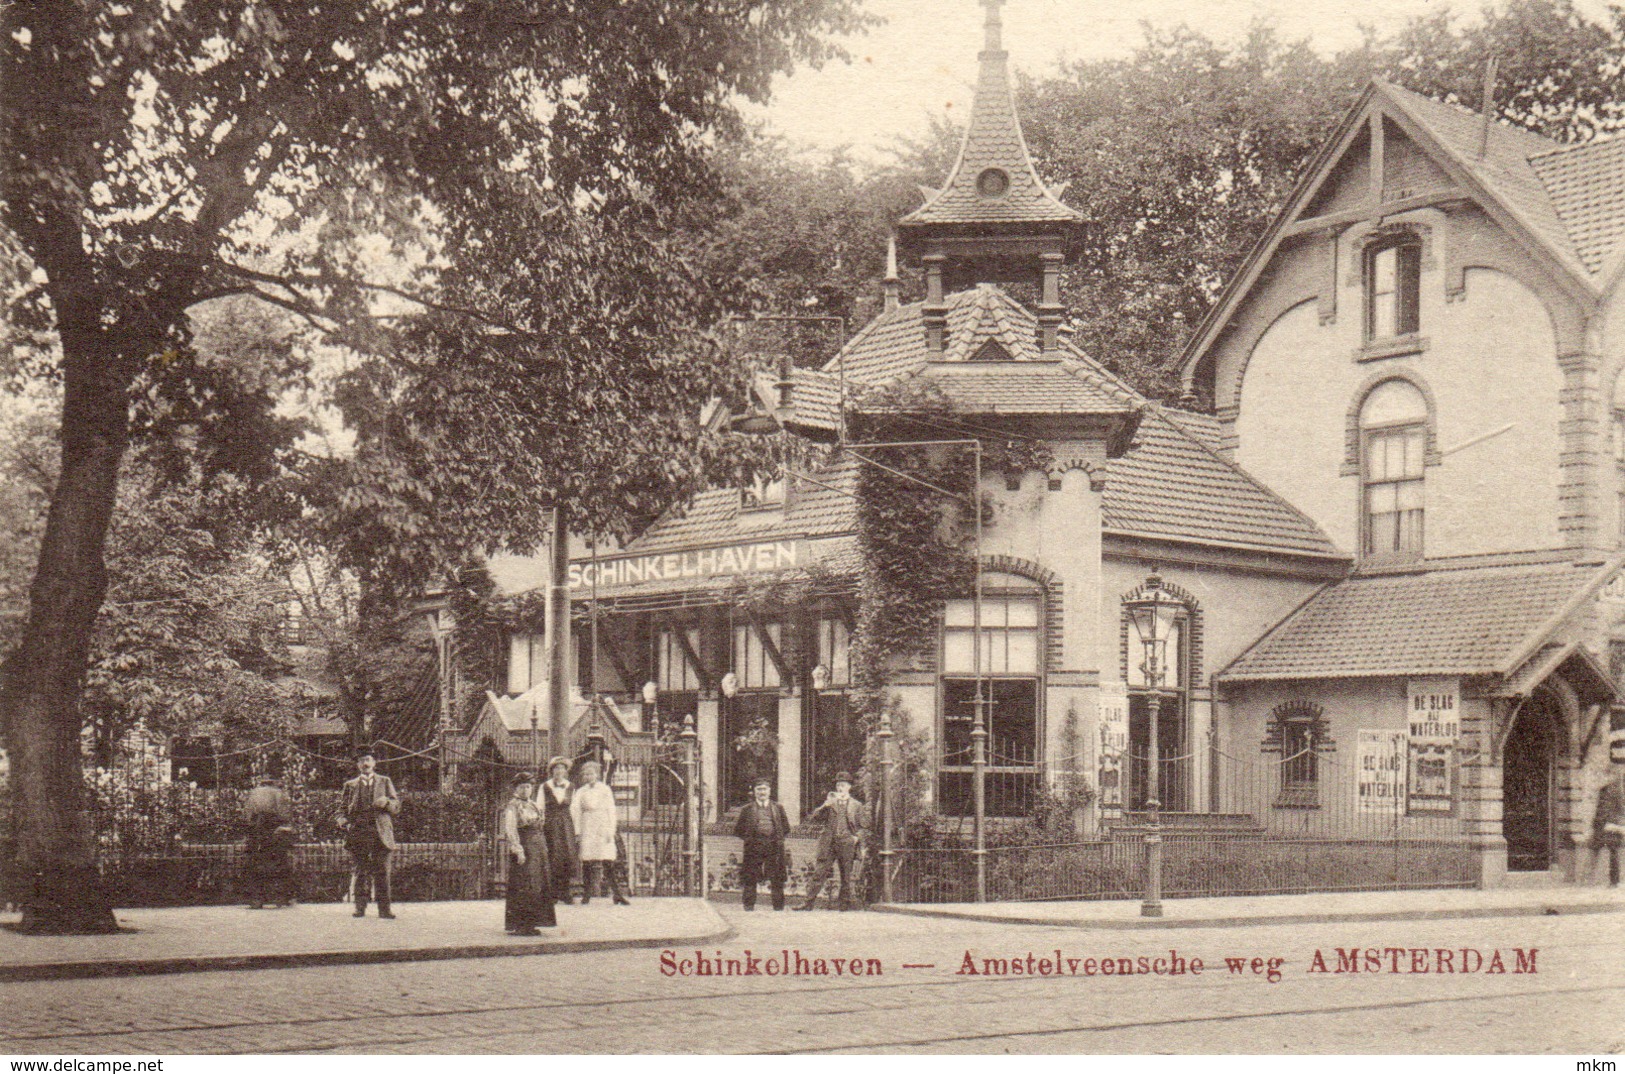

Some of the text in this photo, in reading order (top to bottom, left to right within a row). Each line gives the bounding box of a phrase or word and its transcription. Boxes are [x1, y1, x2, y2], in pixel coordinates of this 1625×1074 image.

[567, 540, 797, 589] SCHINKELHAVEN
[1413, 694, 1454, 711] DE SLAG
[1410, 722, 1458, 737] WATERLOO
[1363, 755, 1376, 771] DE
[1379, 755, 1401, 772] SLAG
